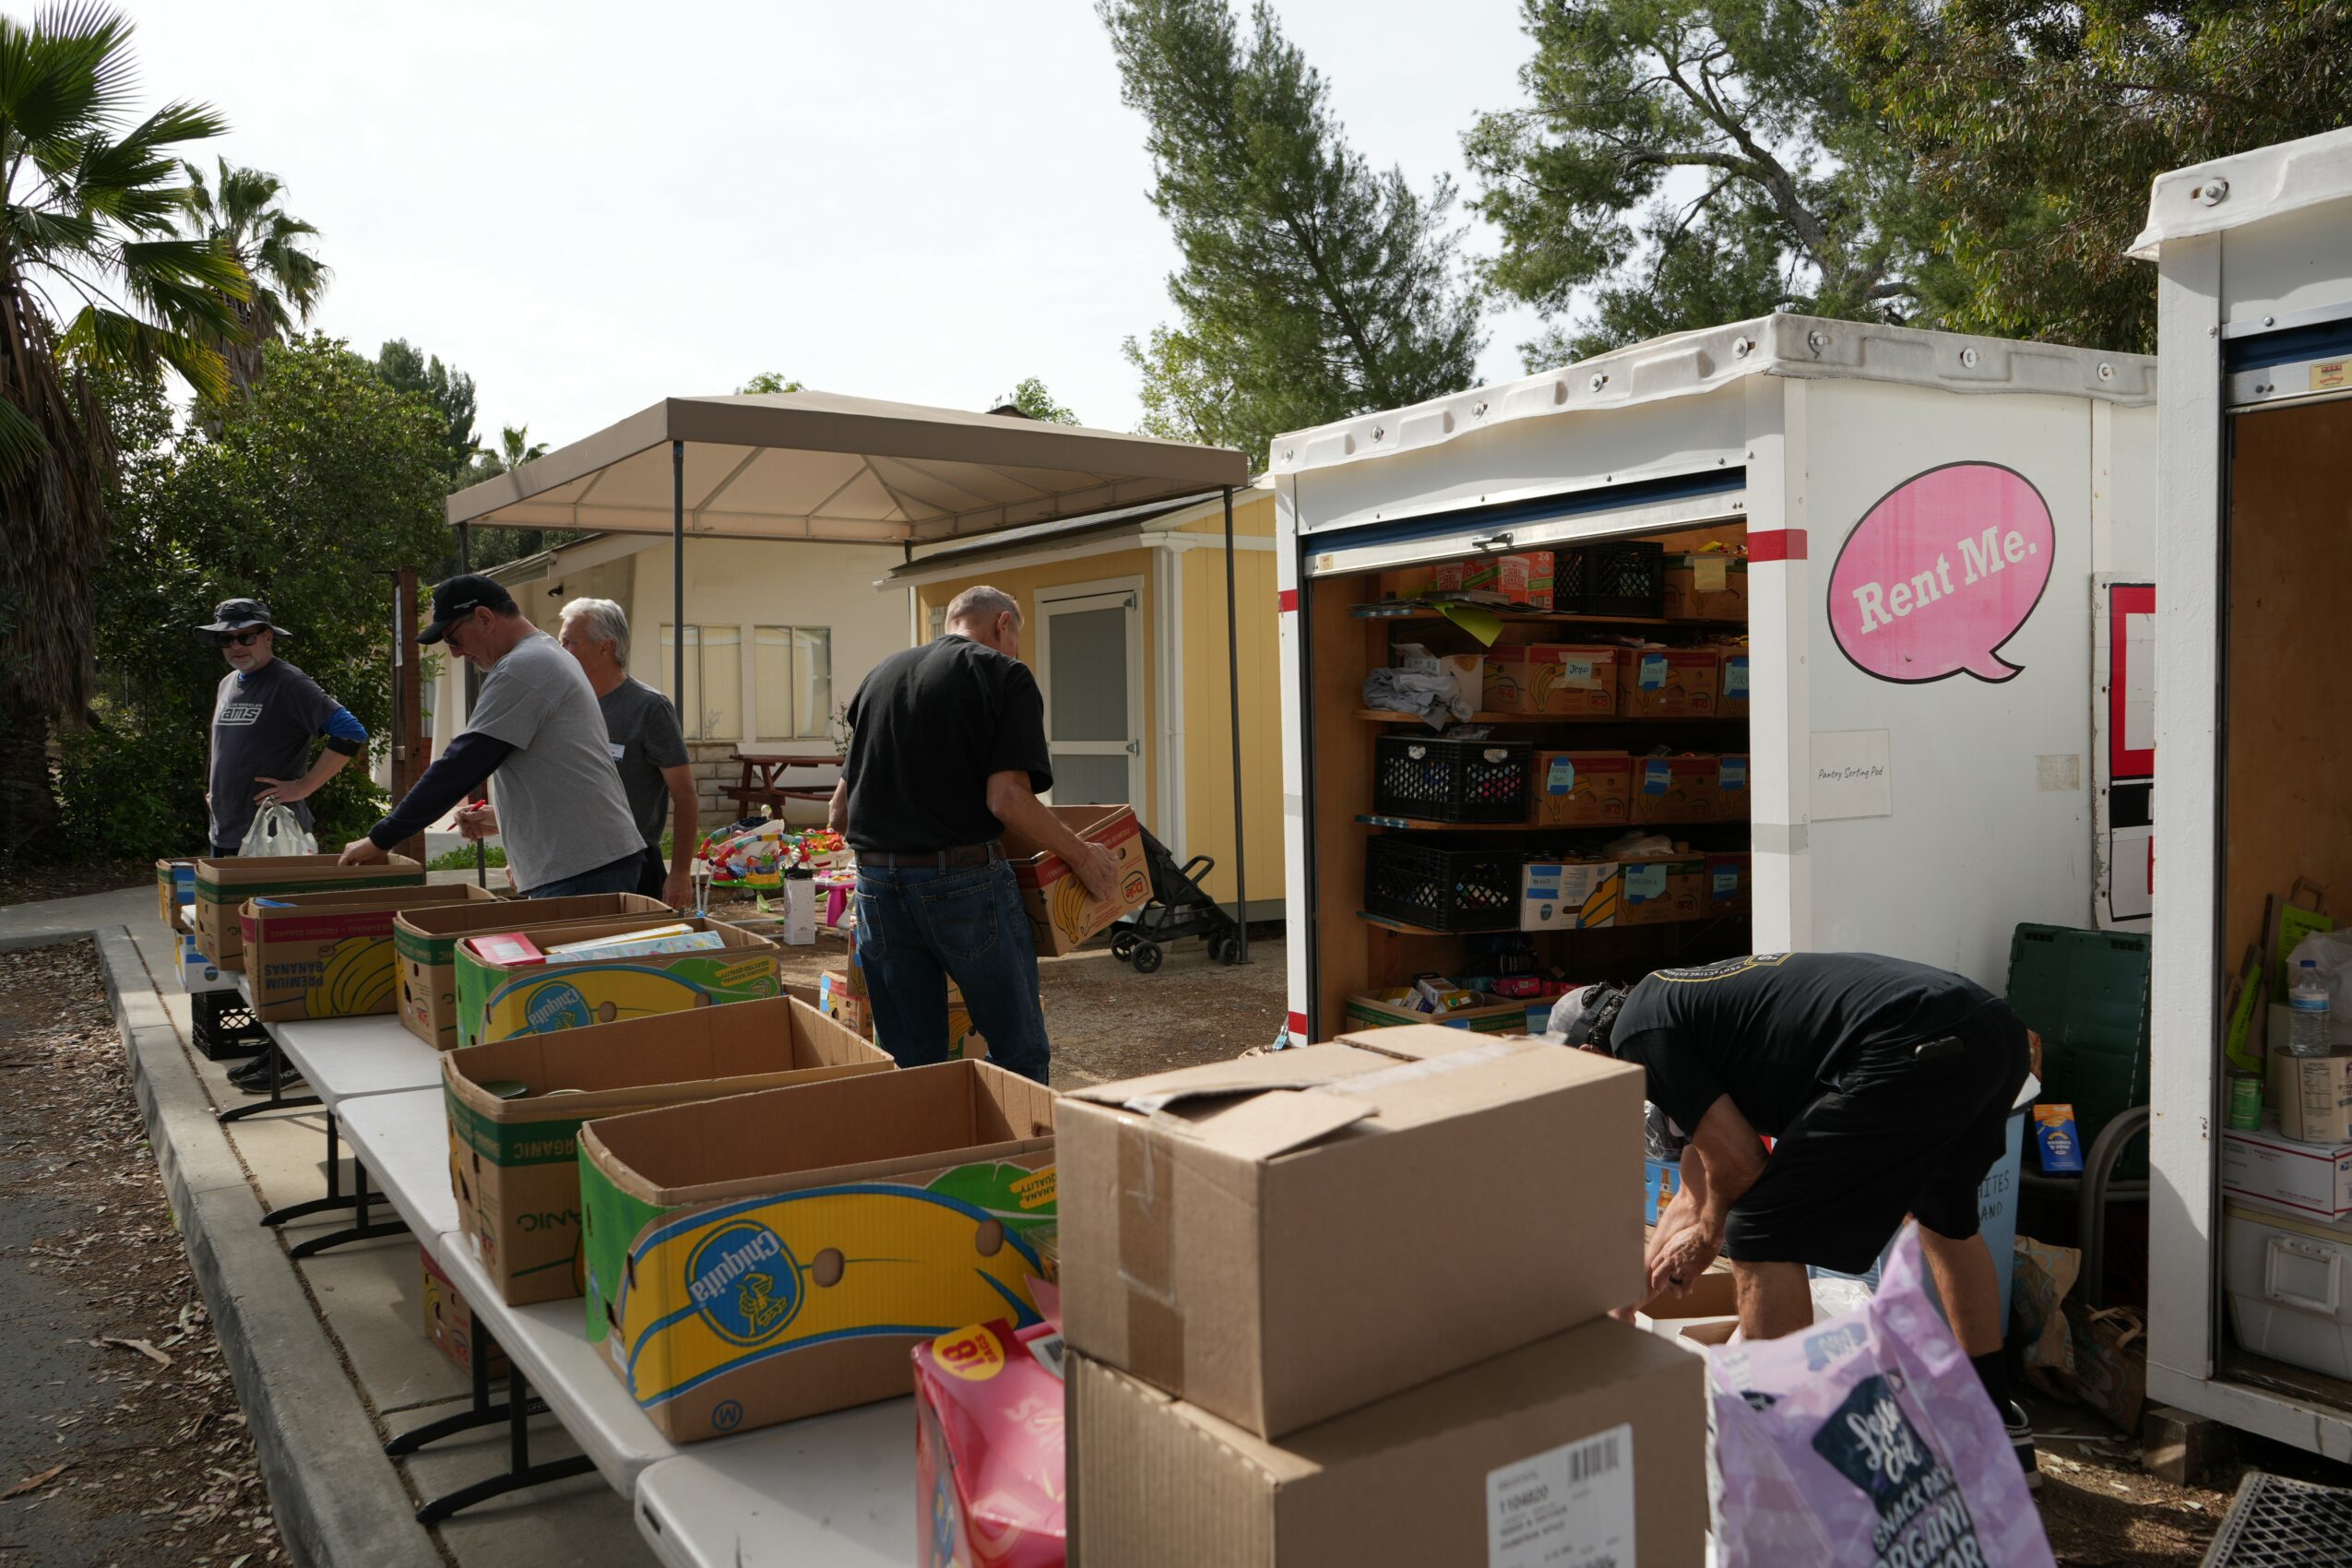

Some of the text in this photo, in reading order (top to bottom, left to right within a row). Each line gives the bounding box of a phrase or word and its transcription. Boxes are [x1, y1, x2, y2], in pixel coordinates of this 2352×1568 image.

[1538, 552, 1550, 562] 24
[1852, 525, 2037, 635] Rent Me.
[221, 707, 259, 721] ams
[1818, 766, 1883, 781] Pantry Sorting Pod
[266, 961, 325, 975] BANANAS
[266, 977, 325, 990] PREMIUM
[528, 987, 580, 1026] Chiquita
[513, 1138, 576, 1159] RGANIC
[1025, 1185, 1056, 1202] ANANA
[517, 1209, 582, 1232] ANIC
[689, 1230, 780, 1301] Chiquita
[942, 1338, 985, 1373] 18
[975, 1334, 999, 1365] BAGS
[1873, 1481, 1926, 1551] SNACK
[1873, 1491, 1969, 1568] RGANI
